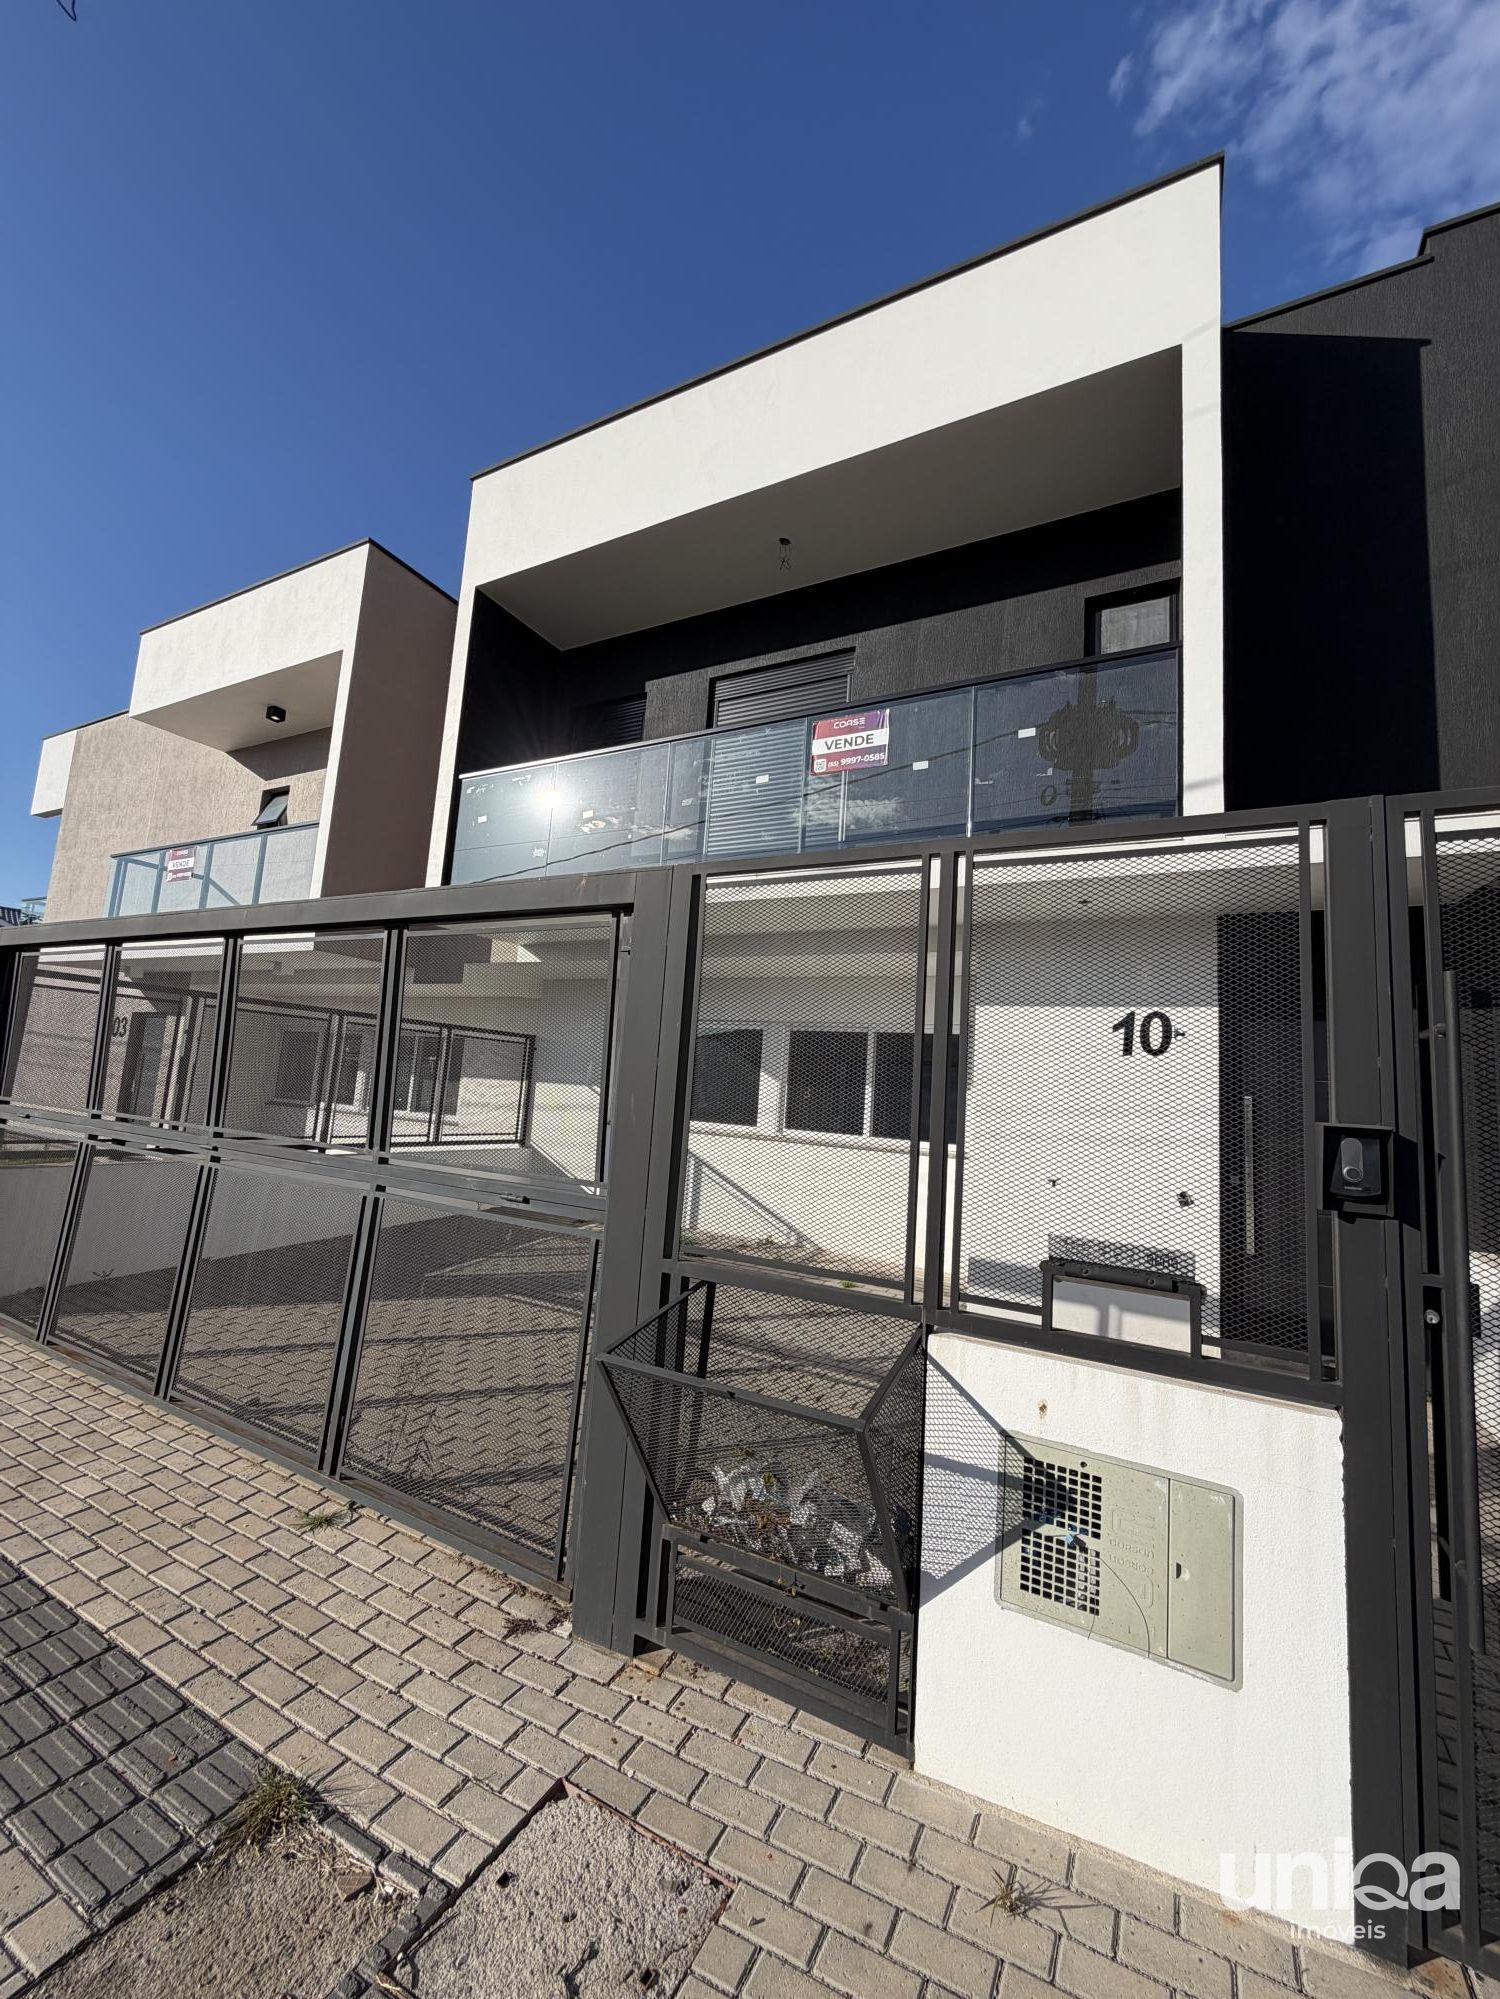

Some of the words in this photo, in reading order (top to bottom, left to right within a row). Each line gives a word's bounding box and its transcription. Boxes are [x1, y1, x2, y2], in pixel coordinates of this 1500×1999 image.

[825, 733, 875, 751] VENDE
[840, 752, 885, 766] 9997-0585
[112, 1016, 128, 1038] 03
[1112, 1011, 1173, 1057] 10
